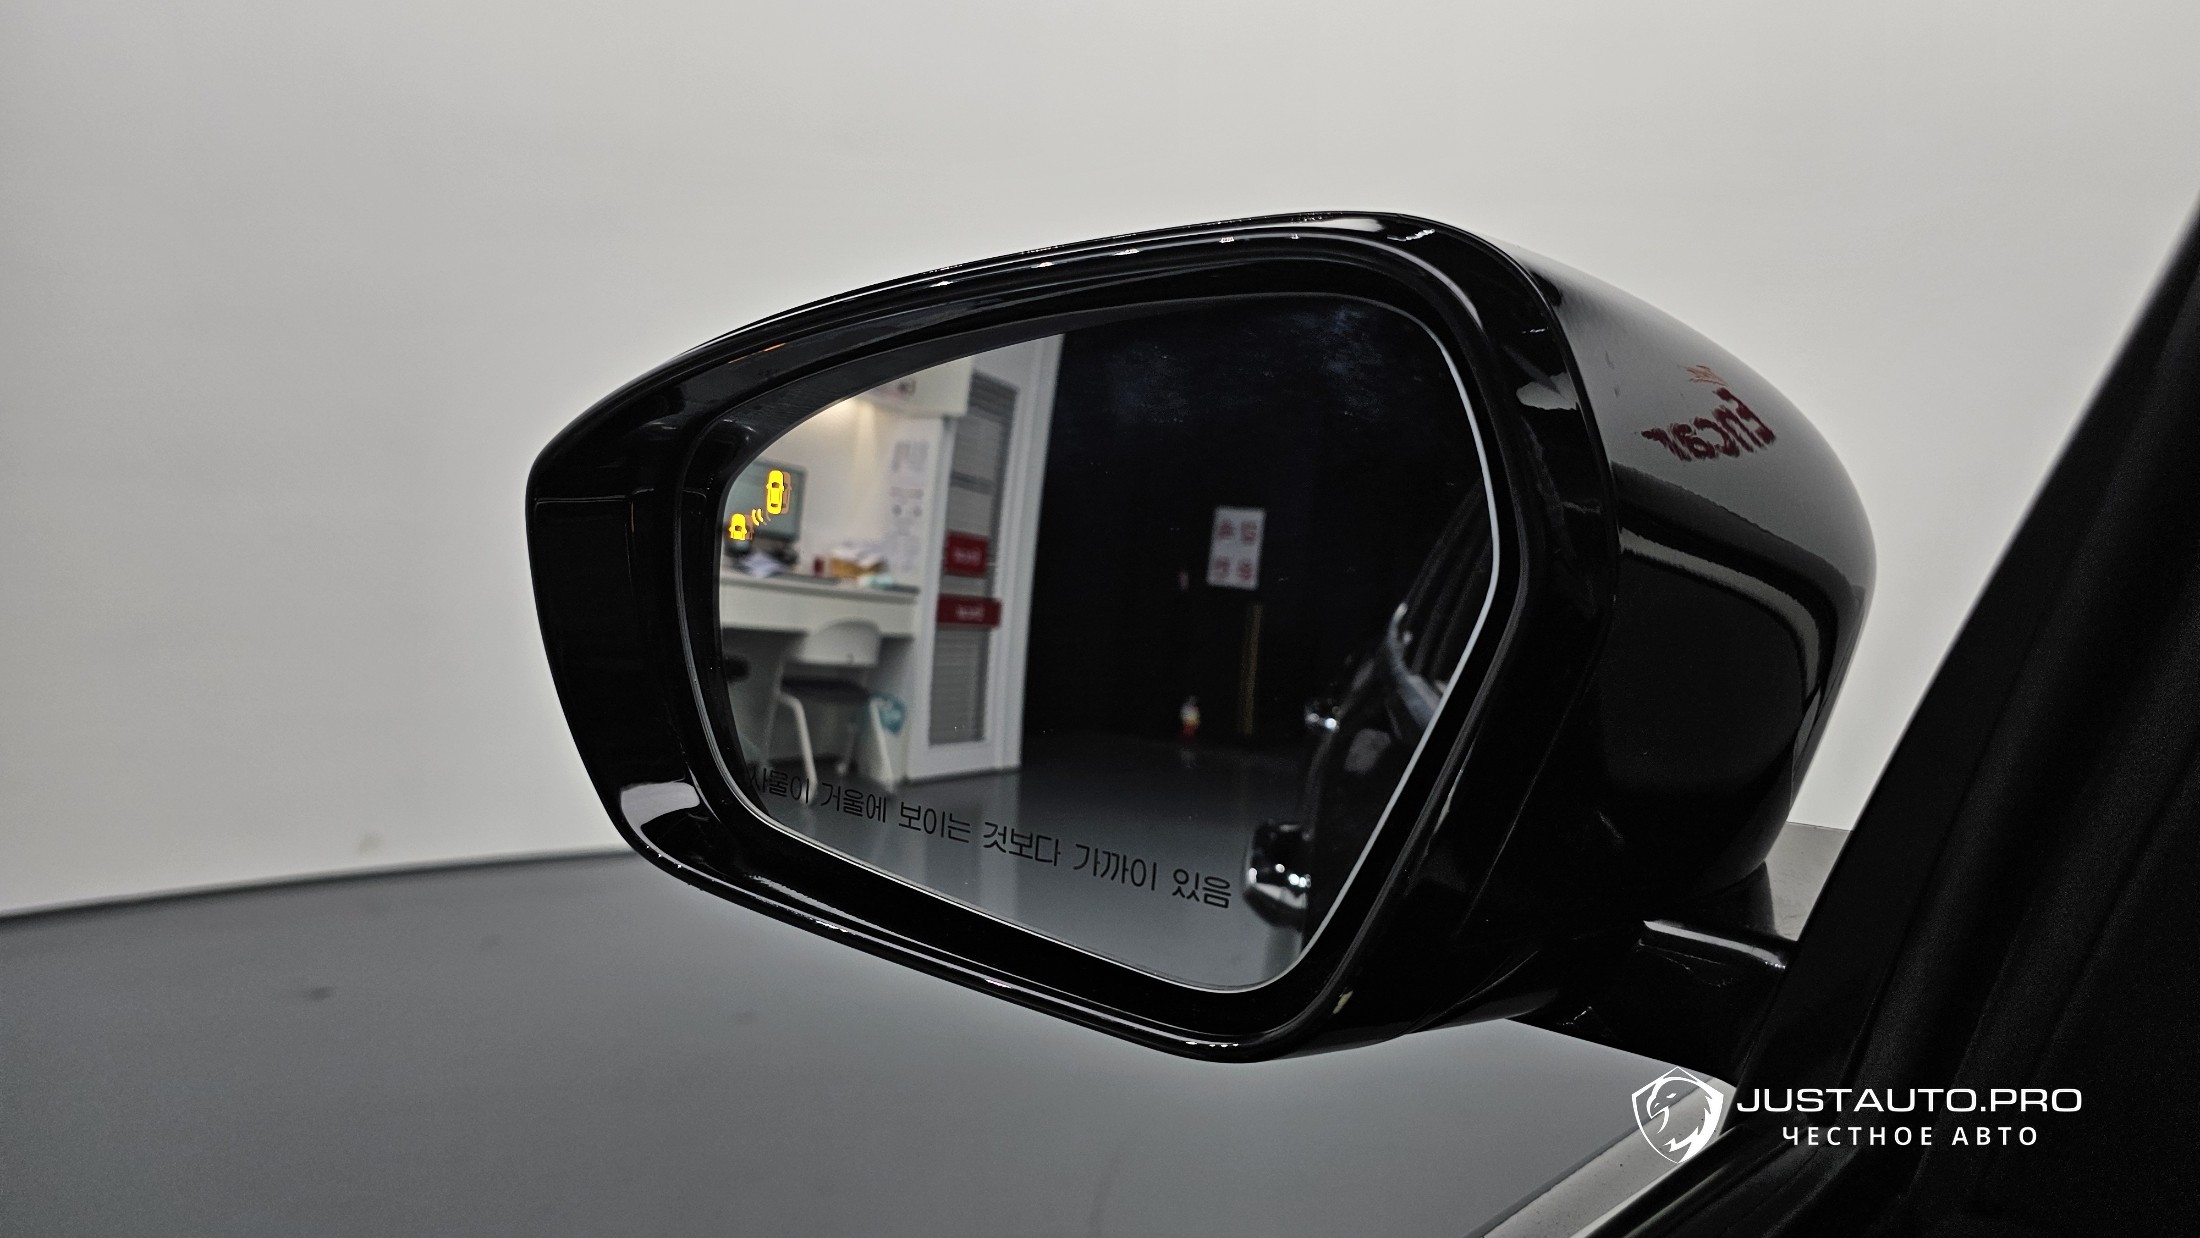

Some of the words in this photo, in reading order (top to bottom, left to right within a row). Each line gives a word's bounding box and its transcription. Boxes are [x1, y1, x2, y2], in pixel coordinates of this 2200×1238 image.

[749, 767, 810, 804] 사물이
[820, 782, 887, 823] 거울에
[899, 802, 971, 843] 보이는
[983, 821, 1061, 866] 것보다
[1073, 843, 1157, 890] 가까이
[1172, 868, 1232, 908] 있음
